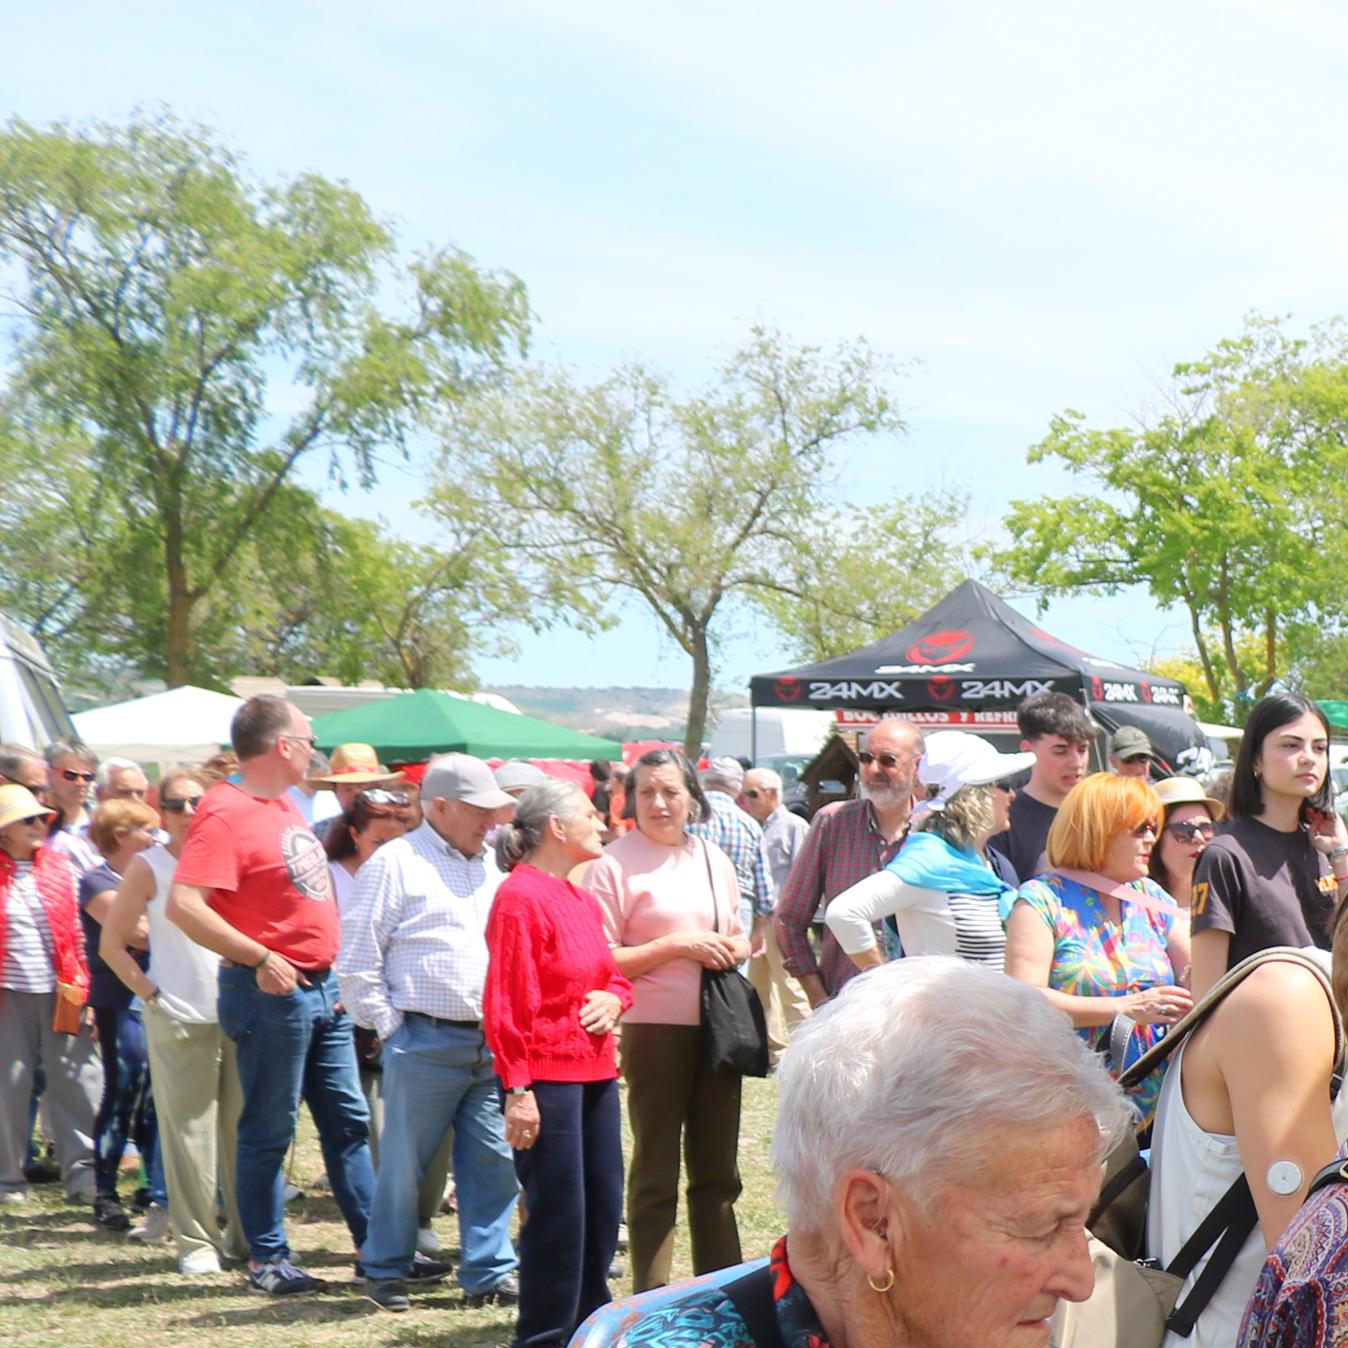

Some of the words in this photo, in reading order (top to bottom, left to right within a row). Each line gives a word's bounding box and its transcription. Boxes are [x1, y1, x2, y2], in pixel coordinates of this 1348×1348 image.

[808, 680, 904, 700] 24MX
[960, 679, 1056, 699] 24MX
[1103, 683, 1139, 702] 24MX
